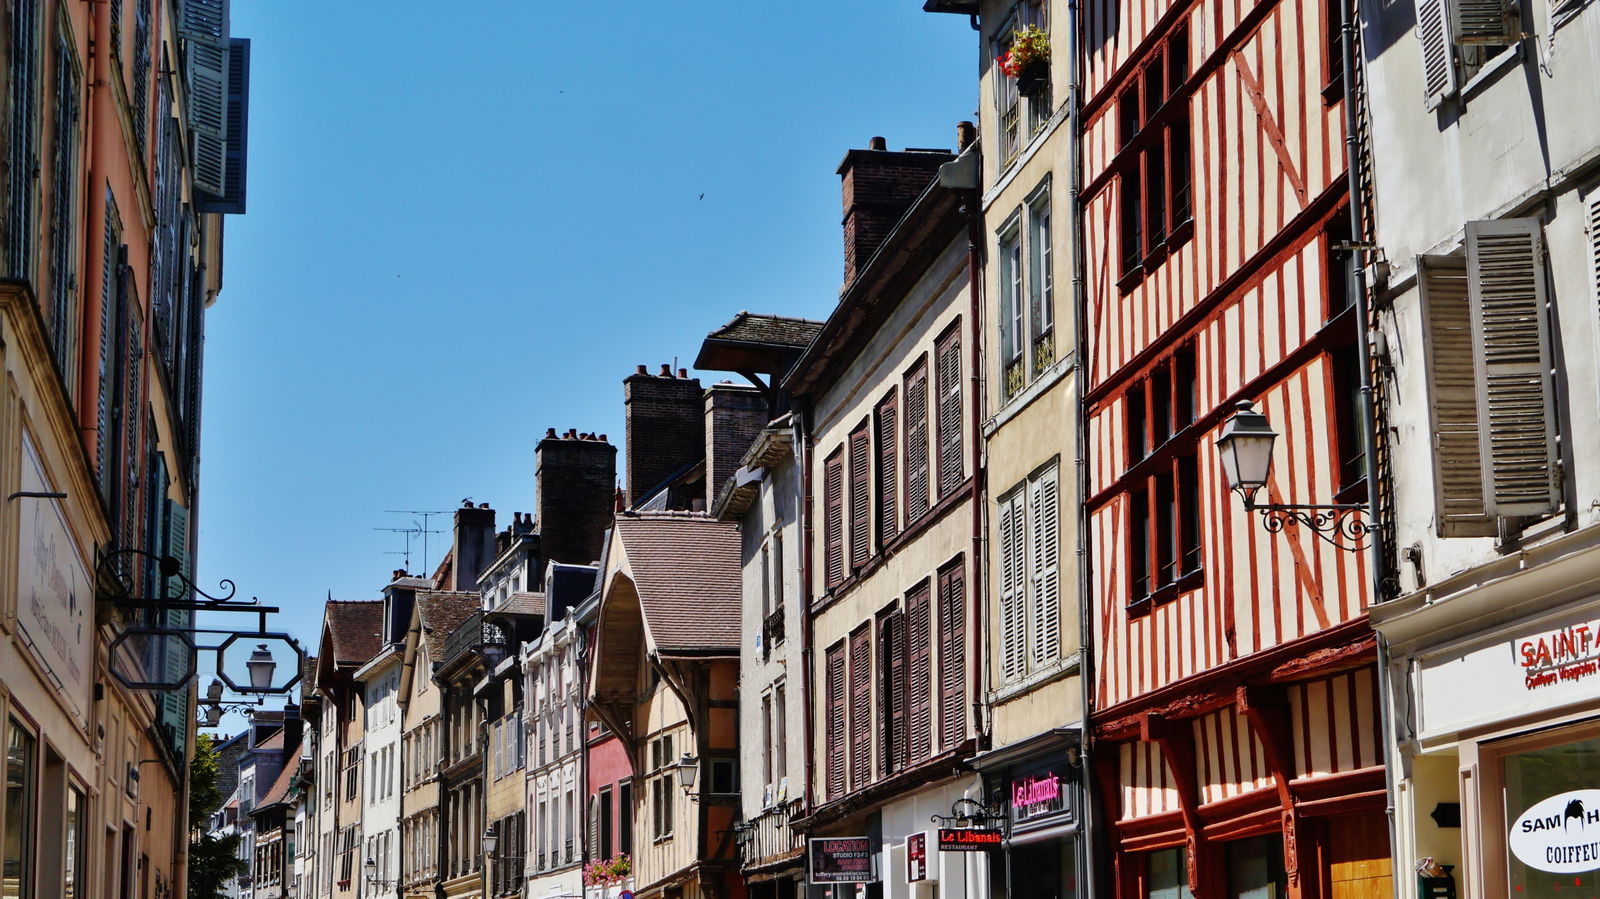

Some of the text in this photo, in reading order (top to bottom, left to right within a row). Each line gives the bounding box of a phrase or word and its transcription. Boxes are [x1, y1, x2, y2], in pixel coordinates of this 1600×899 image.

[1520, 626, 1589, 668] SAINT
[1011, 771, 1060, 809] Le Libanais
[1522, 814, 1561, 833] SAM
[823, 840, 869, 852] LOCATION
[940, 830, 1002, 843] Le Libanais
[1546, 841, 1600, 864] COIFFEU
